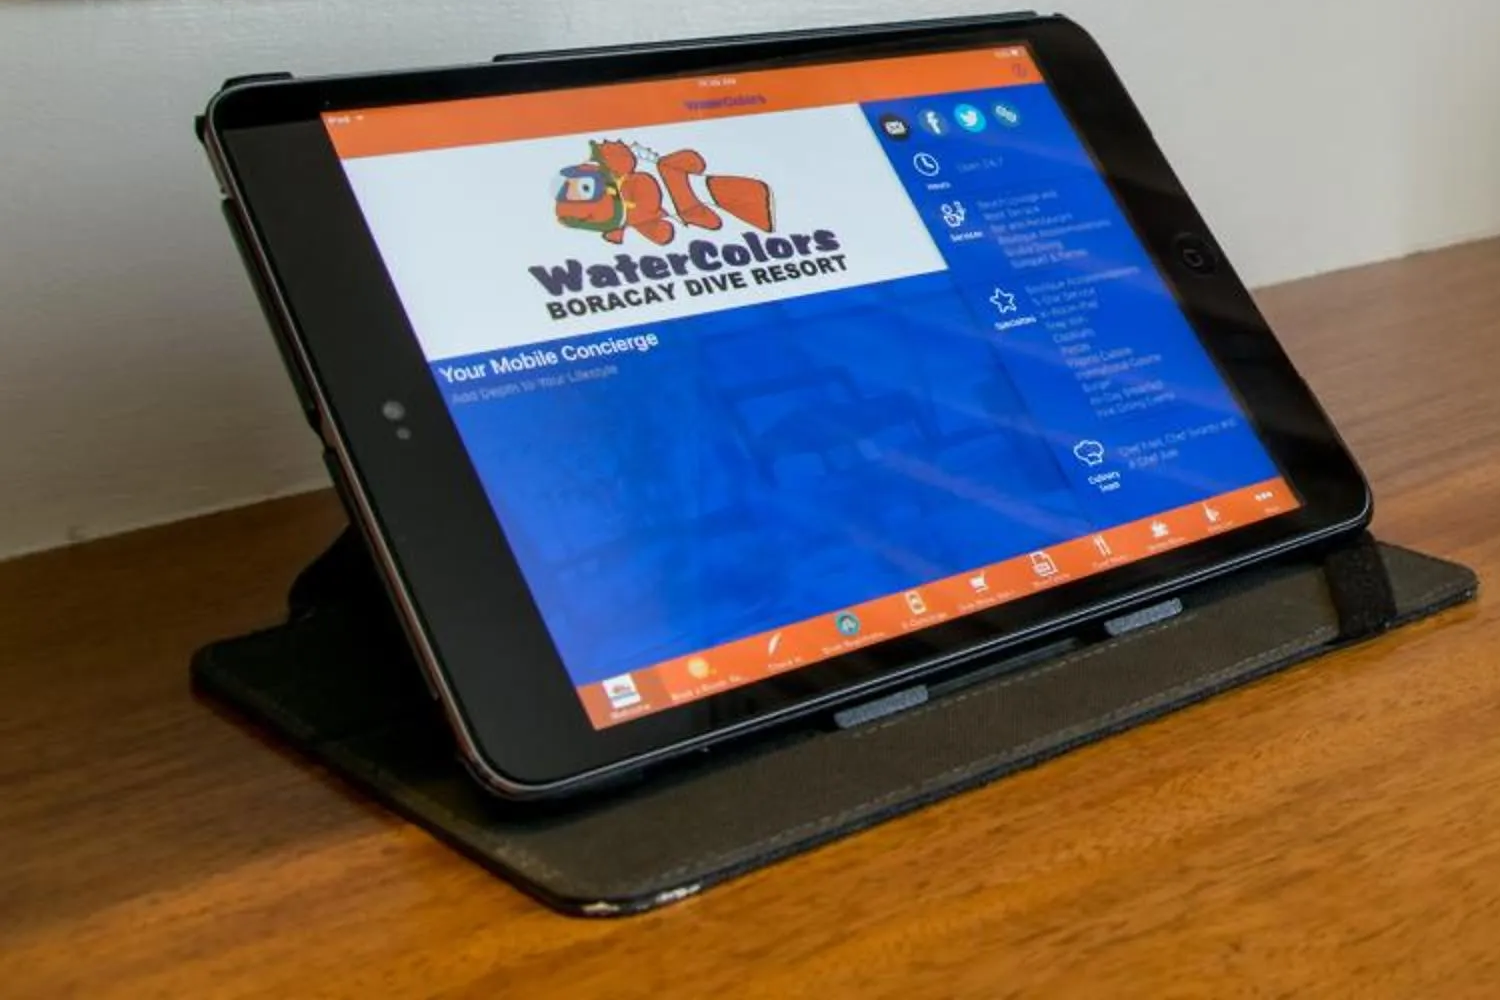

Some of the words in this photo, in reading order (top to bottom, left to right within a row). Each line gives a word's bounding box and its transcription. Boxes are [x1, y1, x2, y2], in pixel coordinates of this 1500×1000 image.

[528, 229, 841, 296] WaterColors
[546, 281, 677, 320] BORACAY
[684, 267, 748, 296] DIVE
[751, 254, 849, 286] RESORT
[438, 364, 487, 384] Your
[490, 350, 559, 375] Mobile
[561, 331, 659, 361] Concierge
[539, 375, 566, 388] Your
